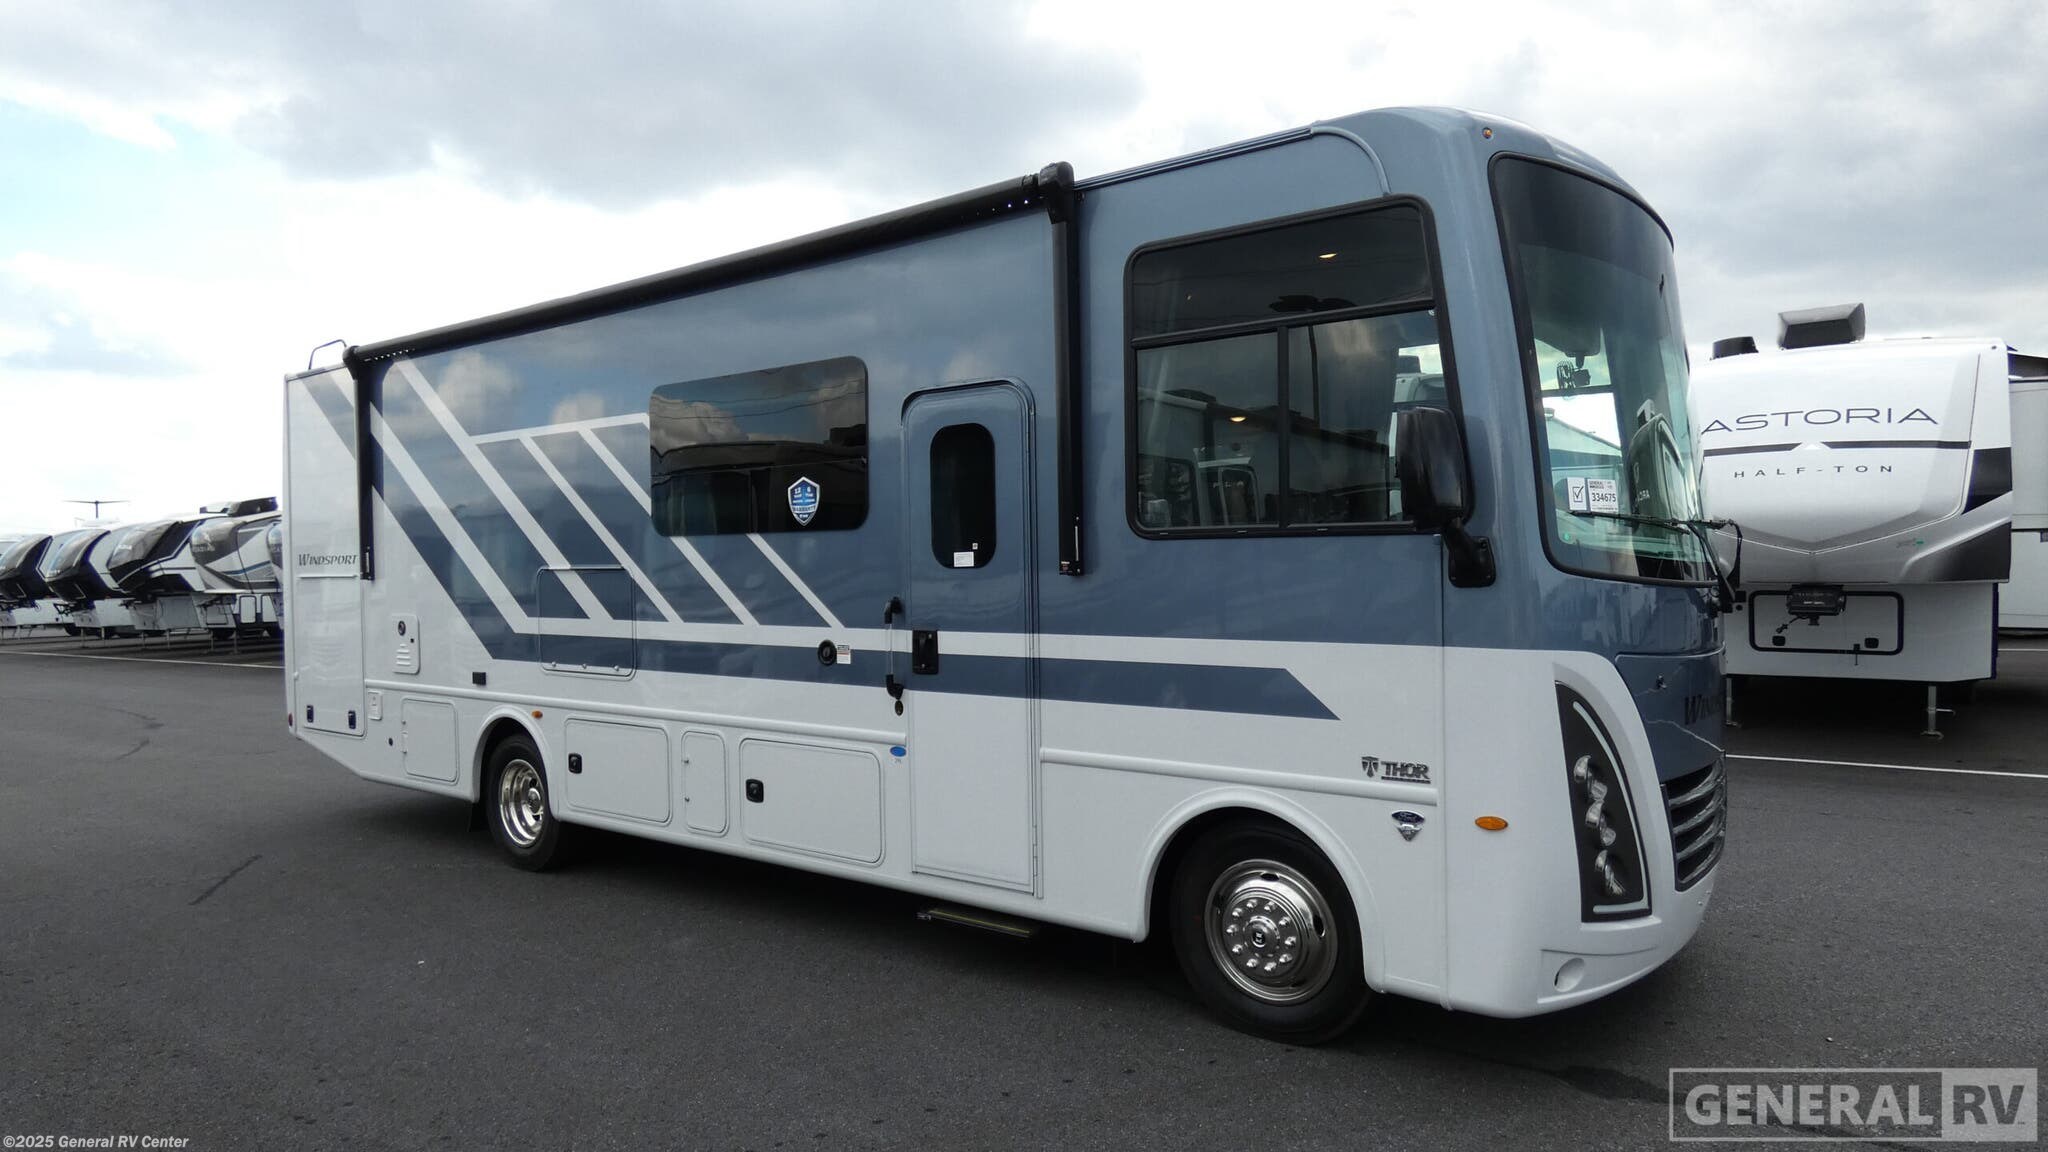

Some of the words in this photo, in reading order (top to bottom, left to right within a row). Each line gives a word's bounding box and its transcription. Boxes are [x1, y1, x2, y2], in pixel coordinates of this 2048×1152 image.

[1701, 408, 1938, 435] ASTORIA
[1734, 465, 1893, 479] HALF-TON
[1591, 492, 1617, 502] 334675
[298, 553, 358, 566] WINDSPORT
[1381, 760, 1430, 780] THOR
